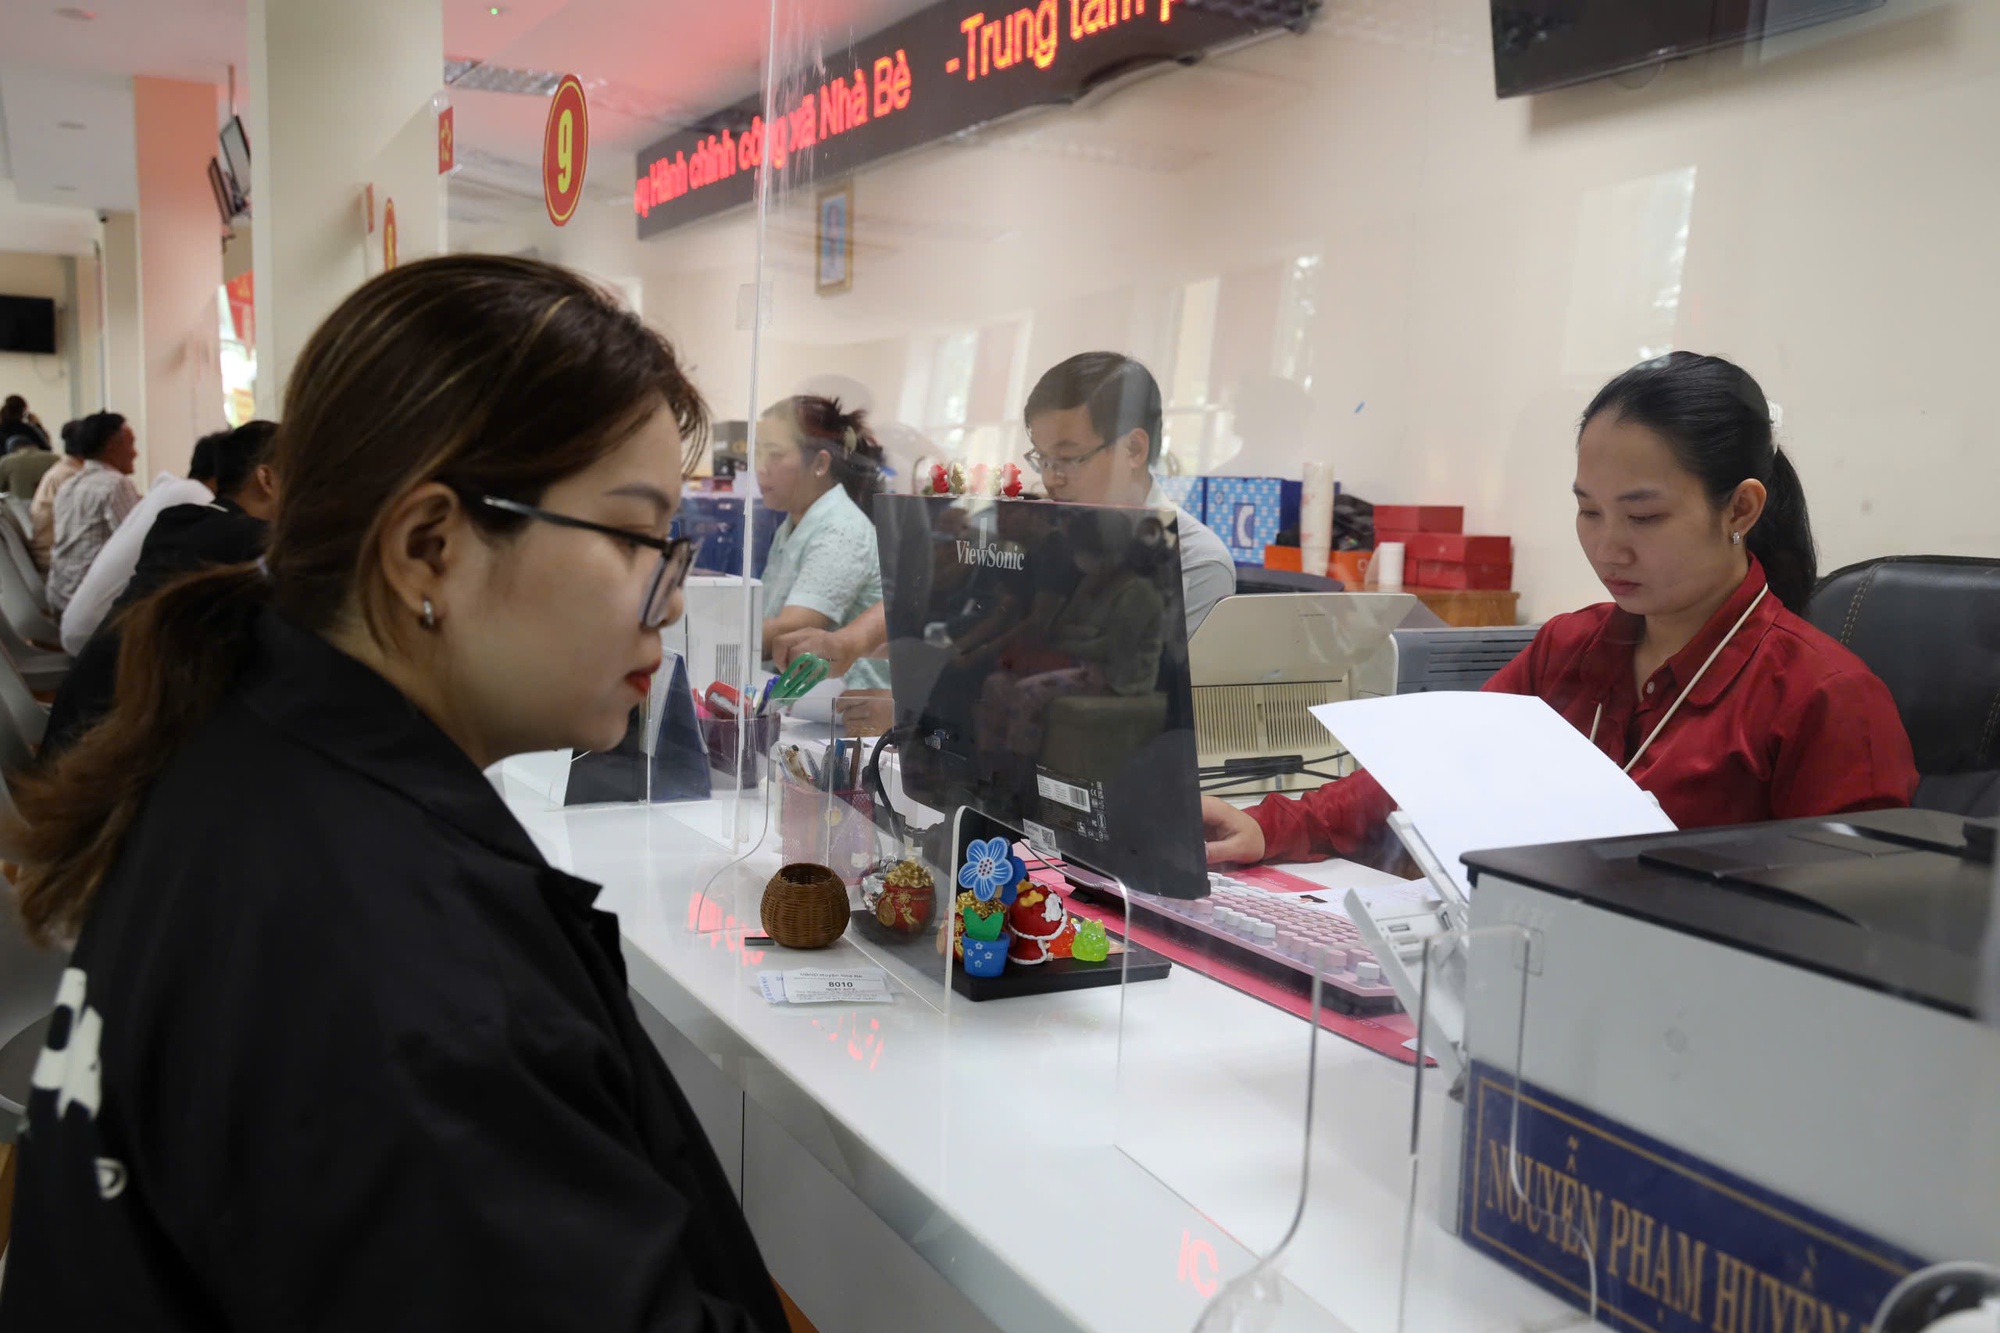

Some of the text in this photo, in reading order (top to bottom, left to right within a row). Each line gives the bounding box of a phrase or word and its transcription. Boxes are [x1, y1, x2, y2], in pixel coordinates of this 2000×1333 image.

[820, 68, 868, 140] Nhà
[873, 49, 911, 118] Bè
[558, 109, 573, 194] 9
[955, 540, 1025, 571] ViewSonic
[1486, 1134, 1602, 1260] NGUYỄN
[1607, 1199, 1706, 1323] PHẠM
